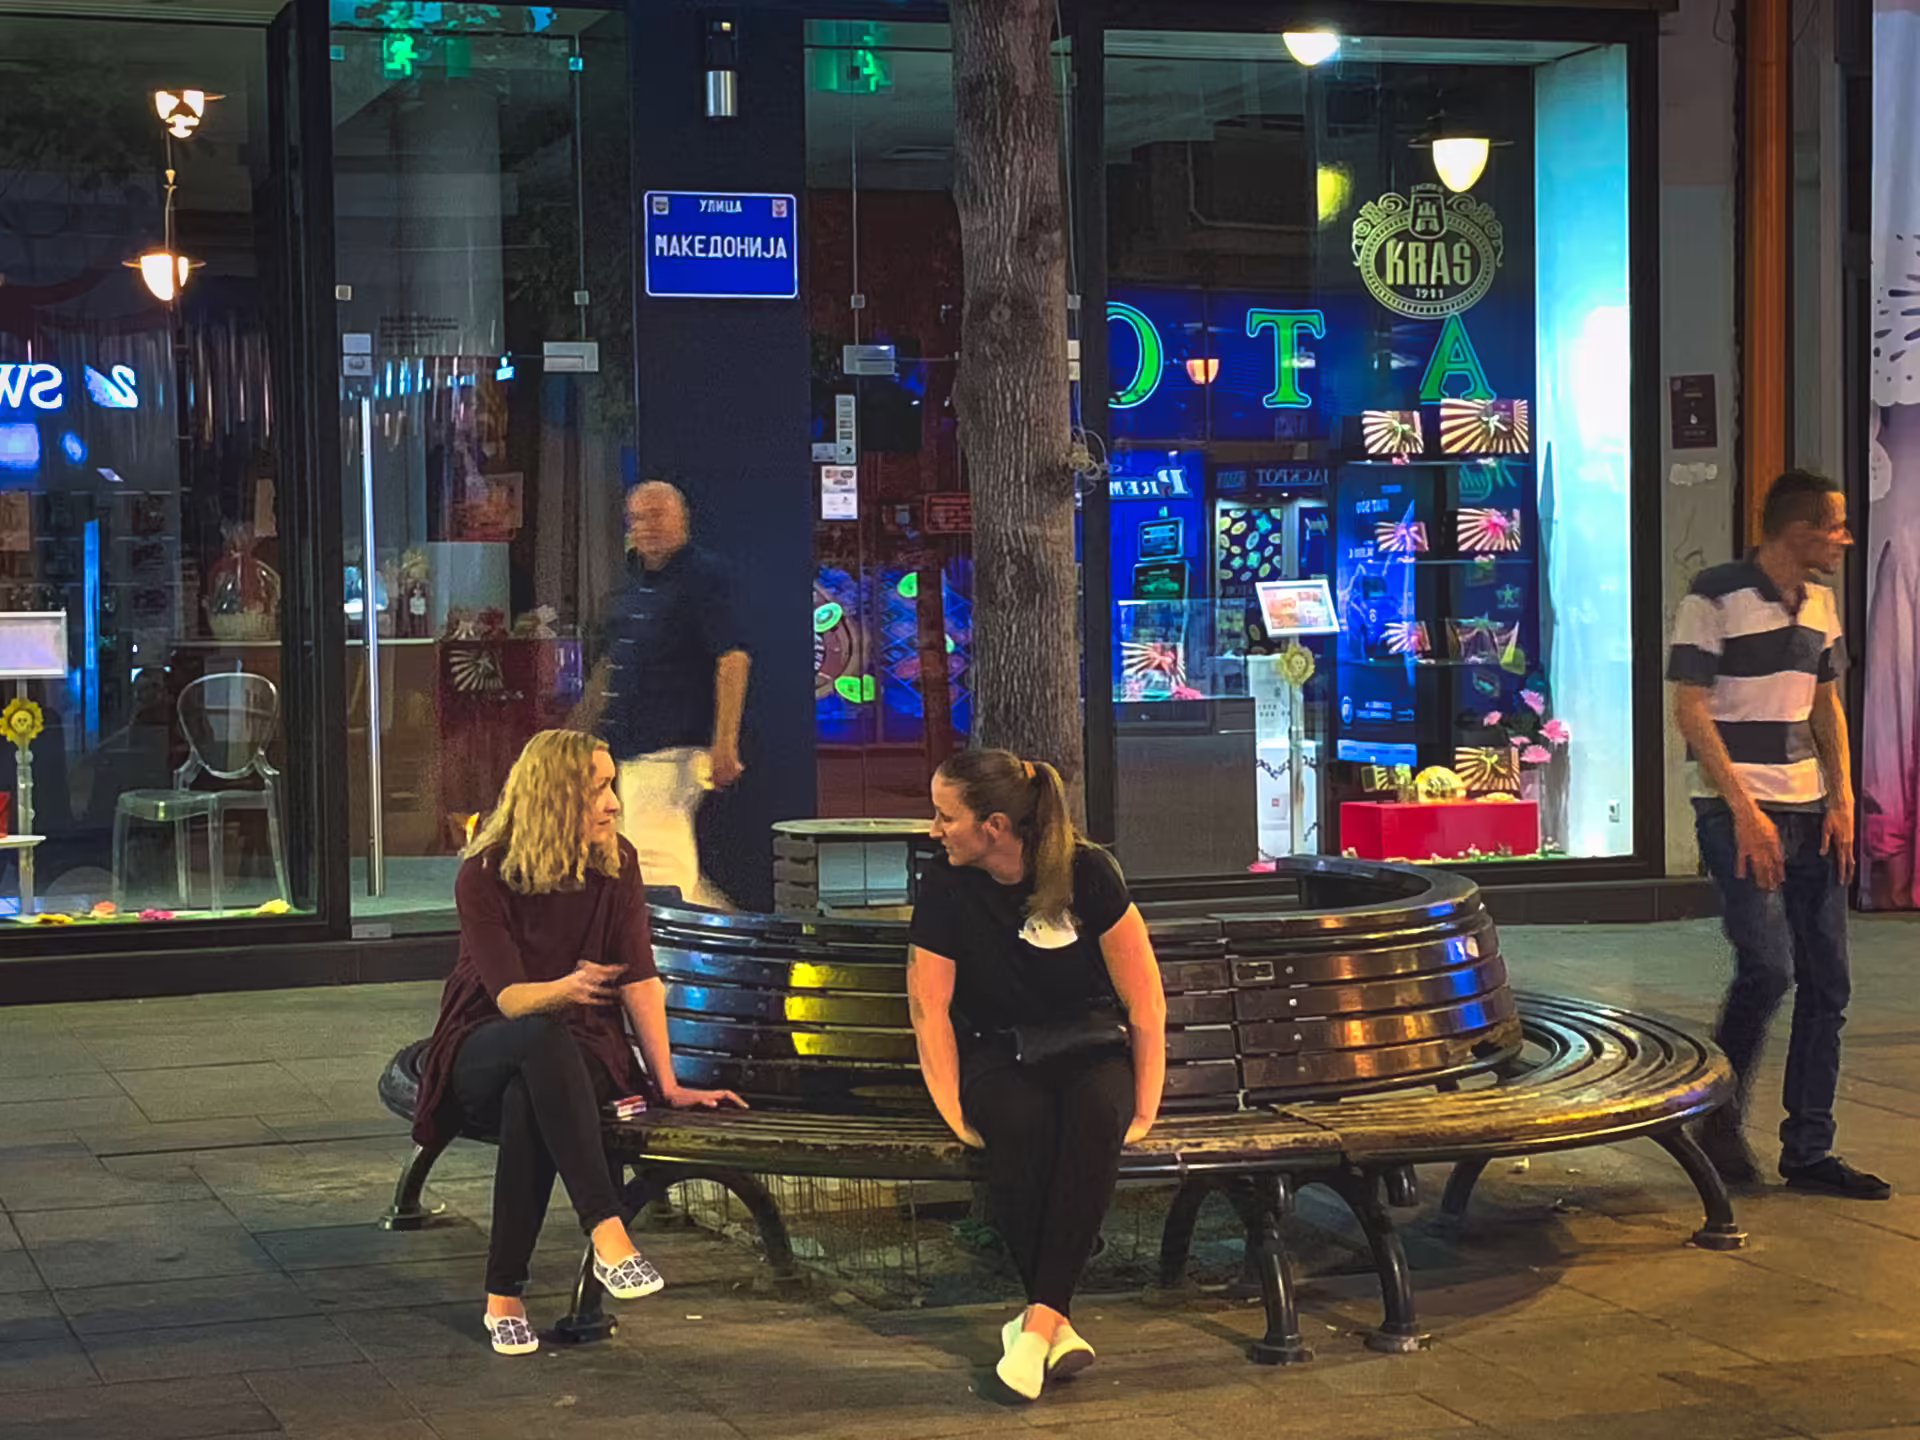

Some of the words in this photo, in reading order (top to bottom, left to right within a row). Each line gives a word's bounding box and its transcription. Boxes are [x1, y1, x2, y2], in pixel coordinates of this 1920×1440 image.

[699, 199, 742, 213] УЛИЦА
[655, 234, 787, 259] МАКЕДОНИЈА
[1415, 288, 1444, 299] 1911
